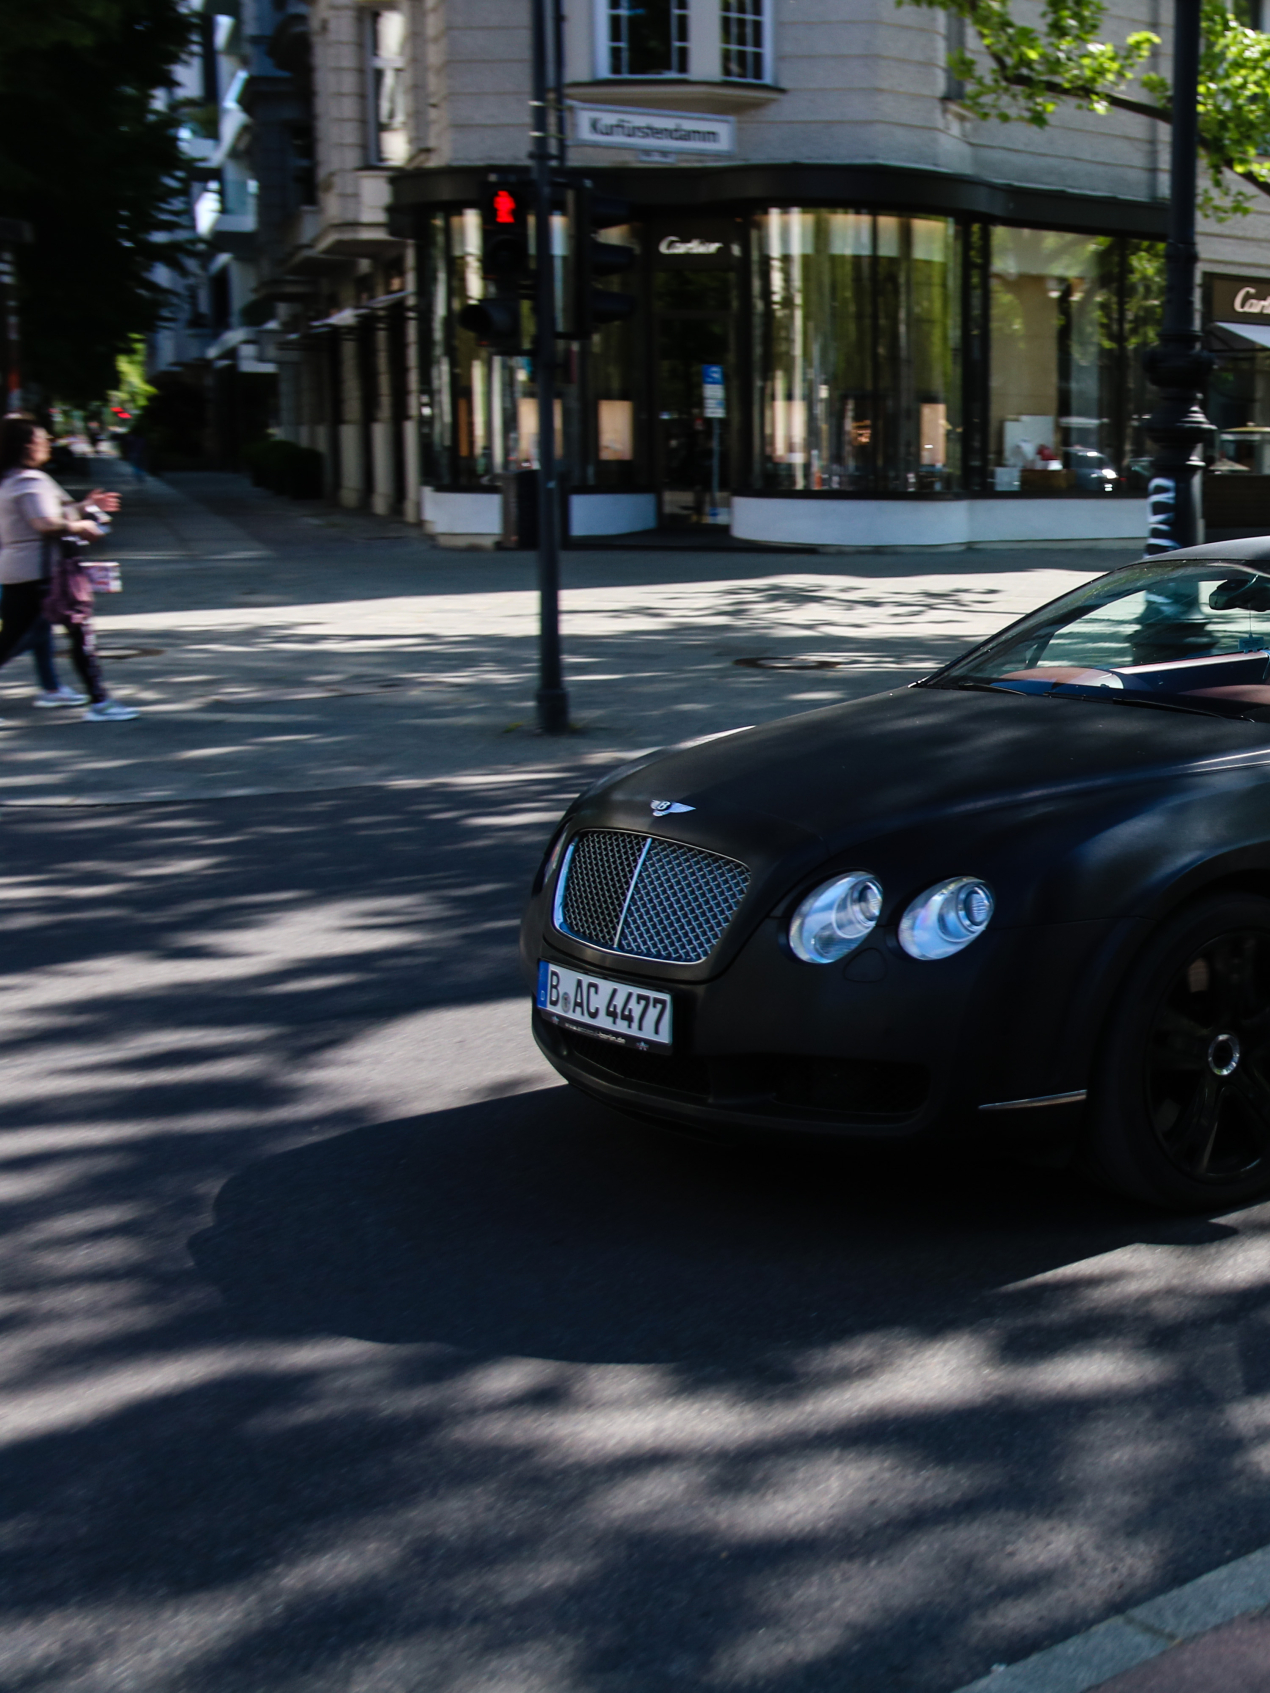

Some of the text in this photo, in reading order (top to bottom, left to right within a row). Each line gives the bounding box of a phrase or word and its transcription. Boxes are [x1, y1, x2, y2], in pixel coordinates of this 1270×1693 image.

[588, 115, 721, 143] Kurfürstendamm
[658, 235, 725, 255] Cartier
[549, 969, 668, 1035] B AC 4477
